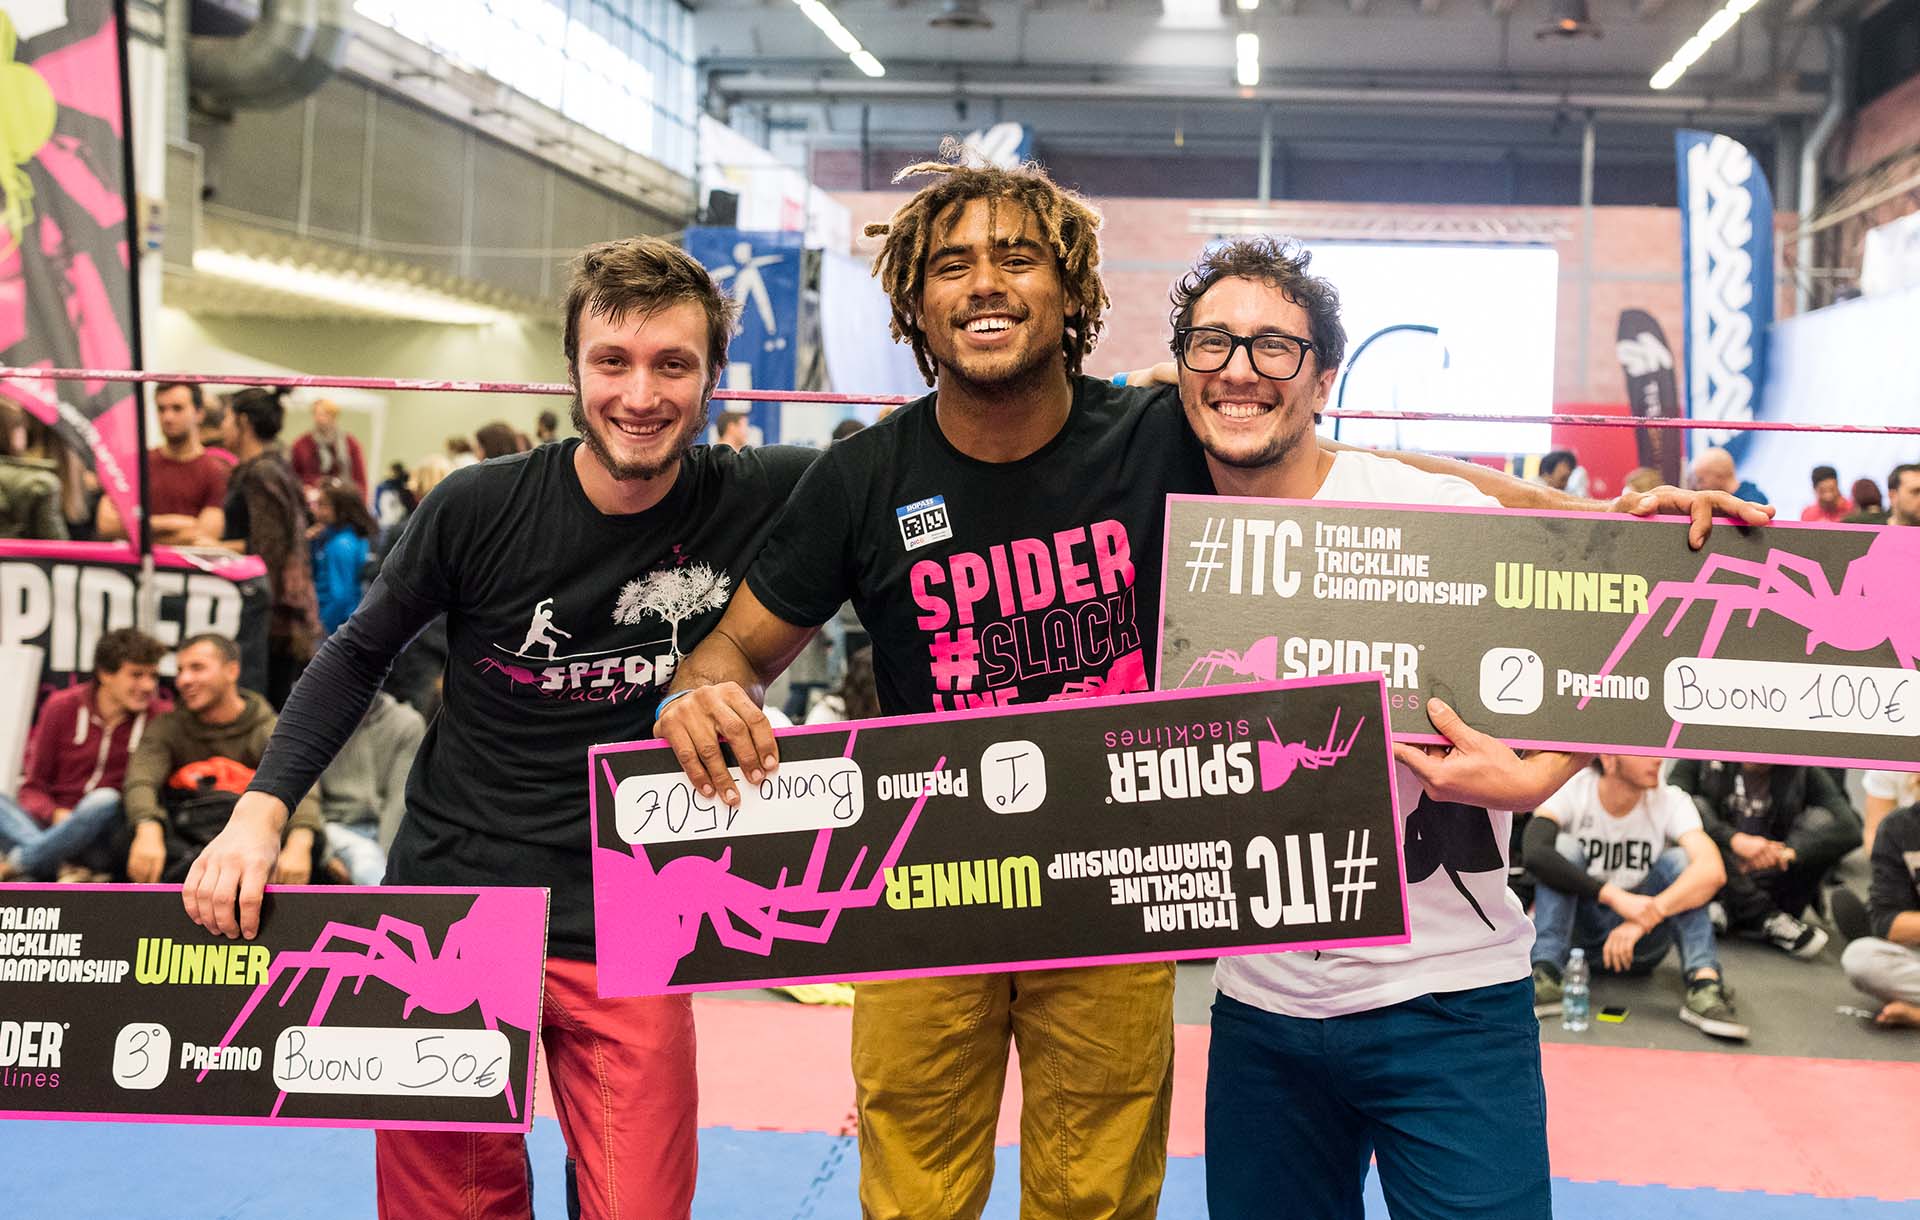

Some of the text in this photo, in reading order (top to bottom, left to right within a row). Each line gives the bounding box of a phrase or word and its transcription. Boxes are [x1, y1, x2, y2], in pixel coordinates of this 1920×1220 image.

[1315, 520, 1401, 550] ITALIAN
[909, 519, 1136, 632] SPIDER
[1185, 517, 1303, 599] #ITC
[1314, 547, 1430, 578] TRICKLINE
[1313, 573, 1488, 606] CHAMPIONSHIP
[1494, 562, 1650, 615] WINNER
[0, 562, 244, 677] PIDER
[541, 655, 677, 690] SPIDE
[1283, 636, 1419, 689] SPIDER
[1556, 668, 1650, 701] PREMIO
[1799, 673, 1910, 723] 100€
[1105, 719, 1250, 748] slacklines
[876, 768, 969, 801] PREMIO
[1107, 741, 1255, 804] SPIDER
[1047, 840, 1233, 880] CHAMPIONSHIP
[1246, 828, 1379, 929] #ITC
[883, 855, 1042, 910] WINNER
[1111, 871, 1236, 905] TRICKLINE
[1143, 900, 1239, 933] ITALIAN
[0, 932, 83, 957] RICKLINE
[135, 938, 271, 985] WINNER
[0, 1021, 64, 1068] DER
[180, 1042, 263, 1072] PREMIO
[398, 1036, 503, 1088] 50€
